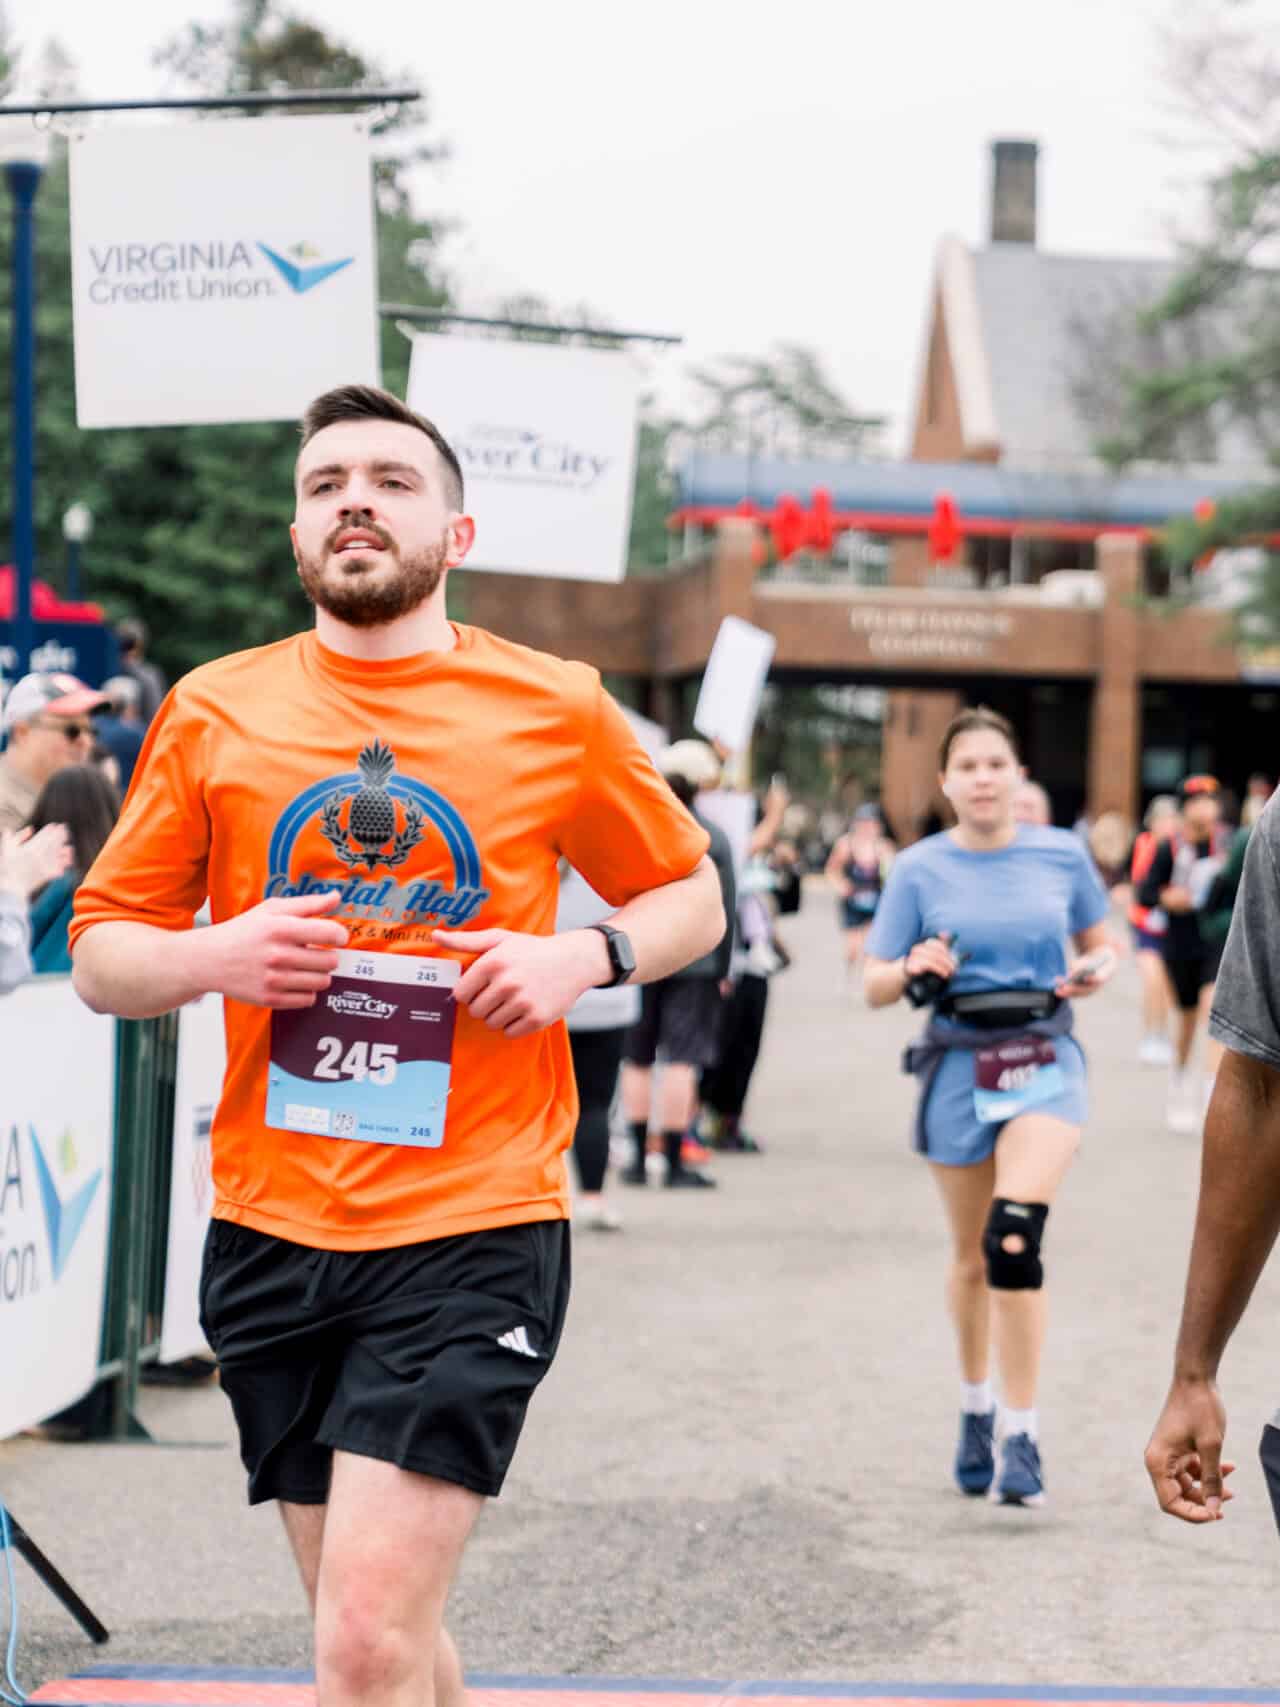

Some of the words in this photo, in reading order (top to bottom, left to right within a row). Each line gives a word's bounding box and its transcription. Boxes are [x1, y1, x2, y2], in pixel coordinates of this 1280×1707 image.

[88, 241, 253, 275] VIRGINIA
[88, 275, 179, 304] Credit
[456, 444, 521, 469] ver
[529, 441, 614, 488] City
[344, 904, 442, 923] ATHON
[405, 880, 490, 927] Half
[354, 964, 375, 977] 245
[416, 970, 438, 982] 245
[327, 994, 363, 1013] River
[364, 998, 398, 1020] City
[313, 1035, 399, 1086] 245
[409, 1126, 431, 1138] 245
